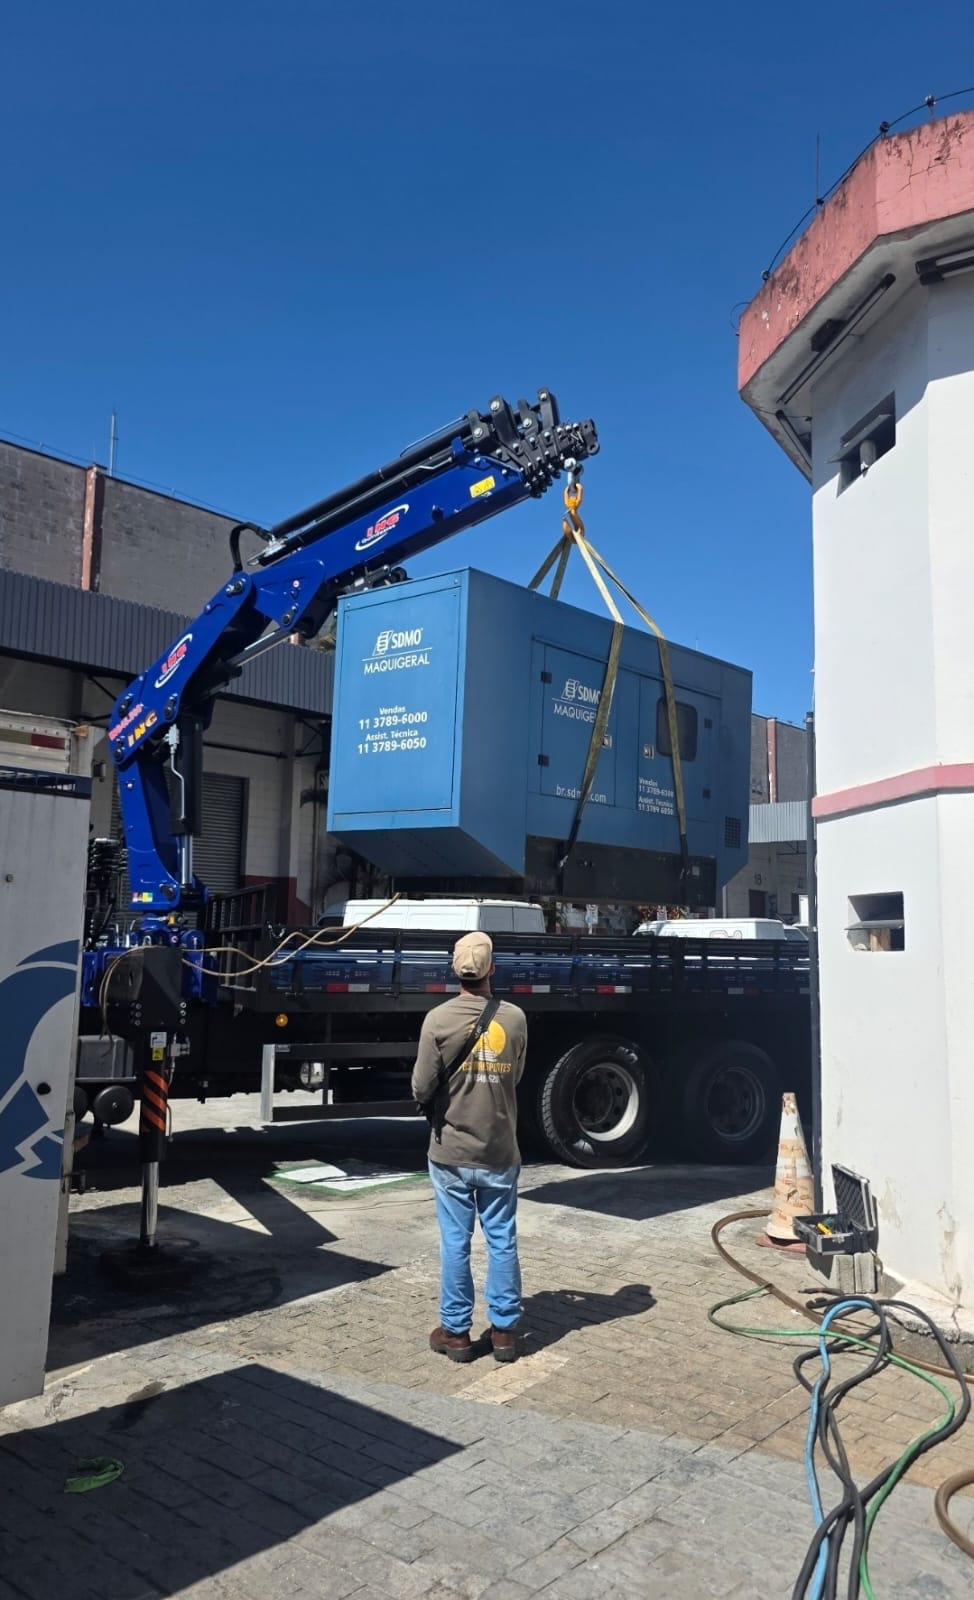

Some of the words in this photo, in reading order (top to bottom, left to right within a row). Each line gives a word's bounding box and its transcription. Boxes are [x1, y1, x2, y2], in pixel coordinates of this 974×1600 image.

[391, 628, 422, 649] SDMO
[363, 653, 430, 675] MAQUIGERAL
[379, 705, 406, 715] Vendas
[359, 719, 370, 730] 11
[373, 712, 428, 729] 3789-6000
[358, 744, 369, 755] 11
[372, 737, 427, 753] 3789-6050
